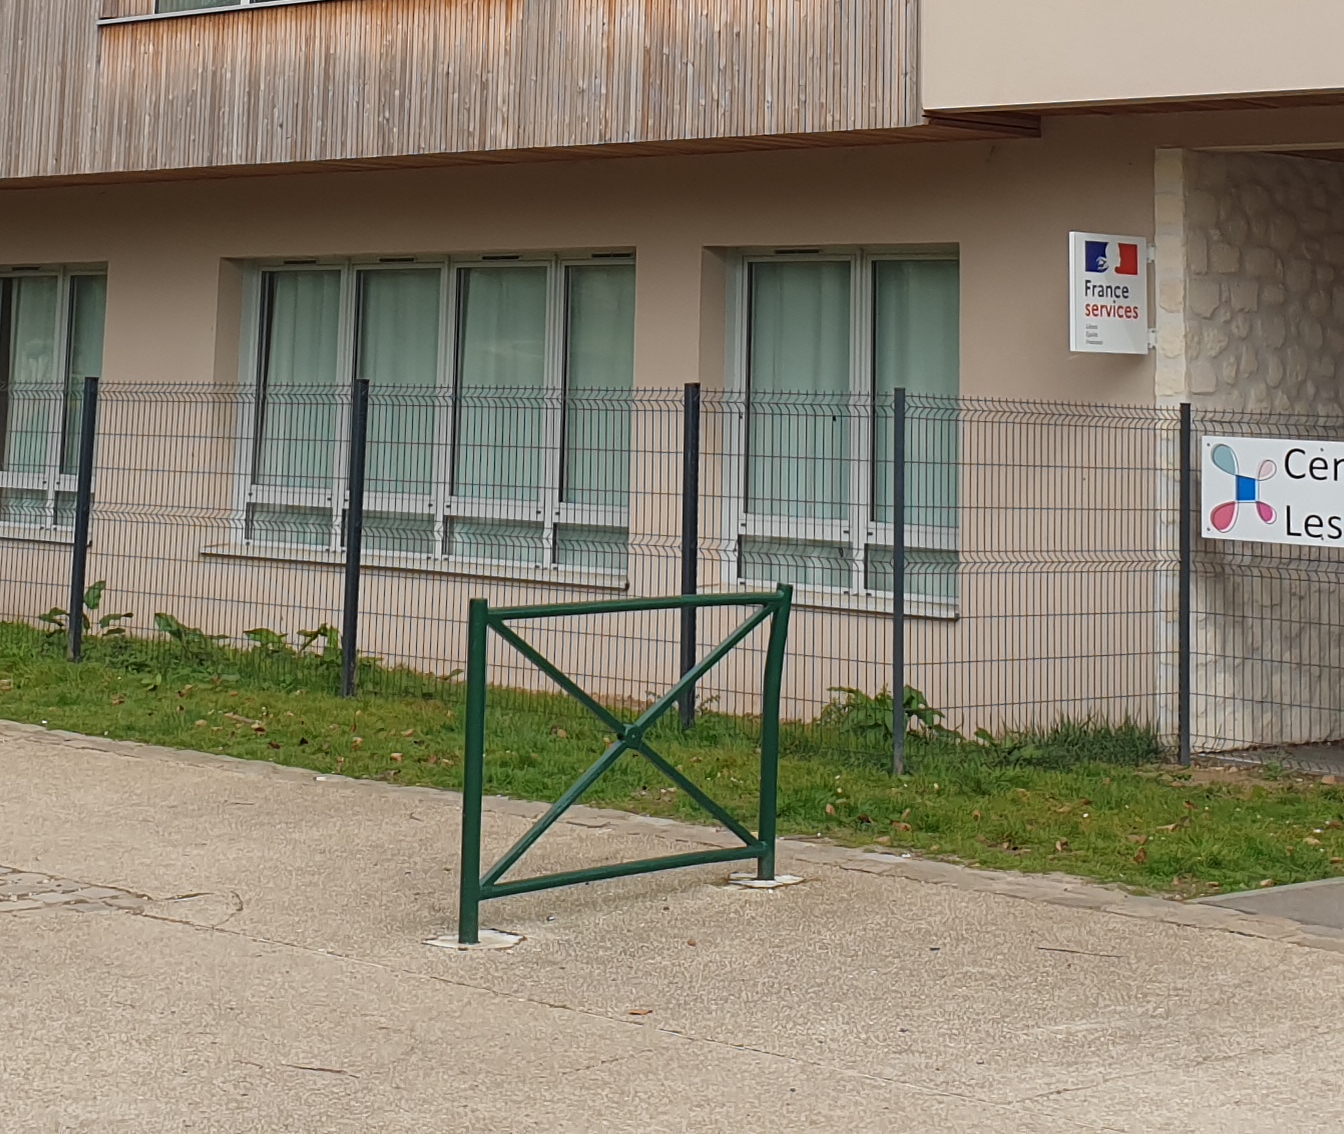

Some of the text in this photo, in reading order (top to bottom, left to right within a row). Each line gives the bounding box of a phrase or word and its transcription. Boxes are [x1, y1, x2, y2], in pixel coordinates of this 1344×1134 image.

[1084, 279, 1130, 299] France
[1084, 299, 1139, 319] services
[1284, 504, 1344, 540] Les
